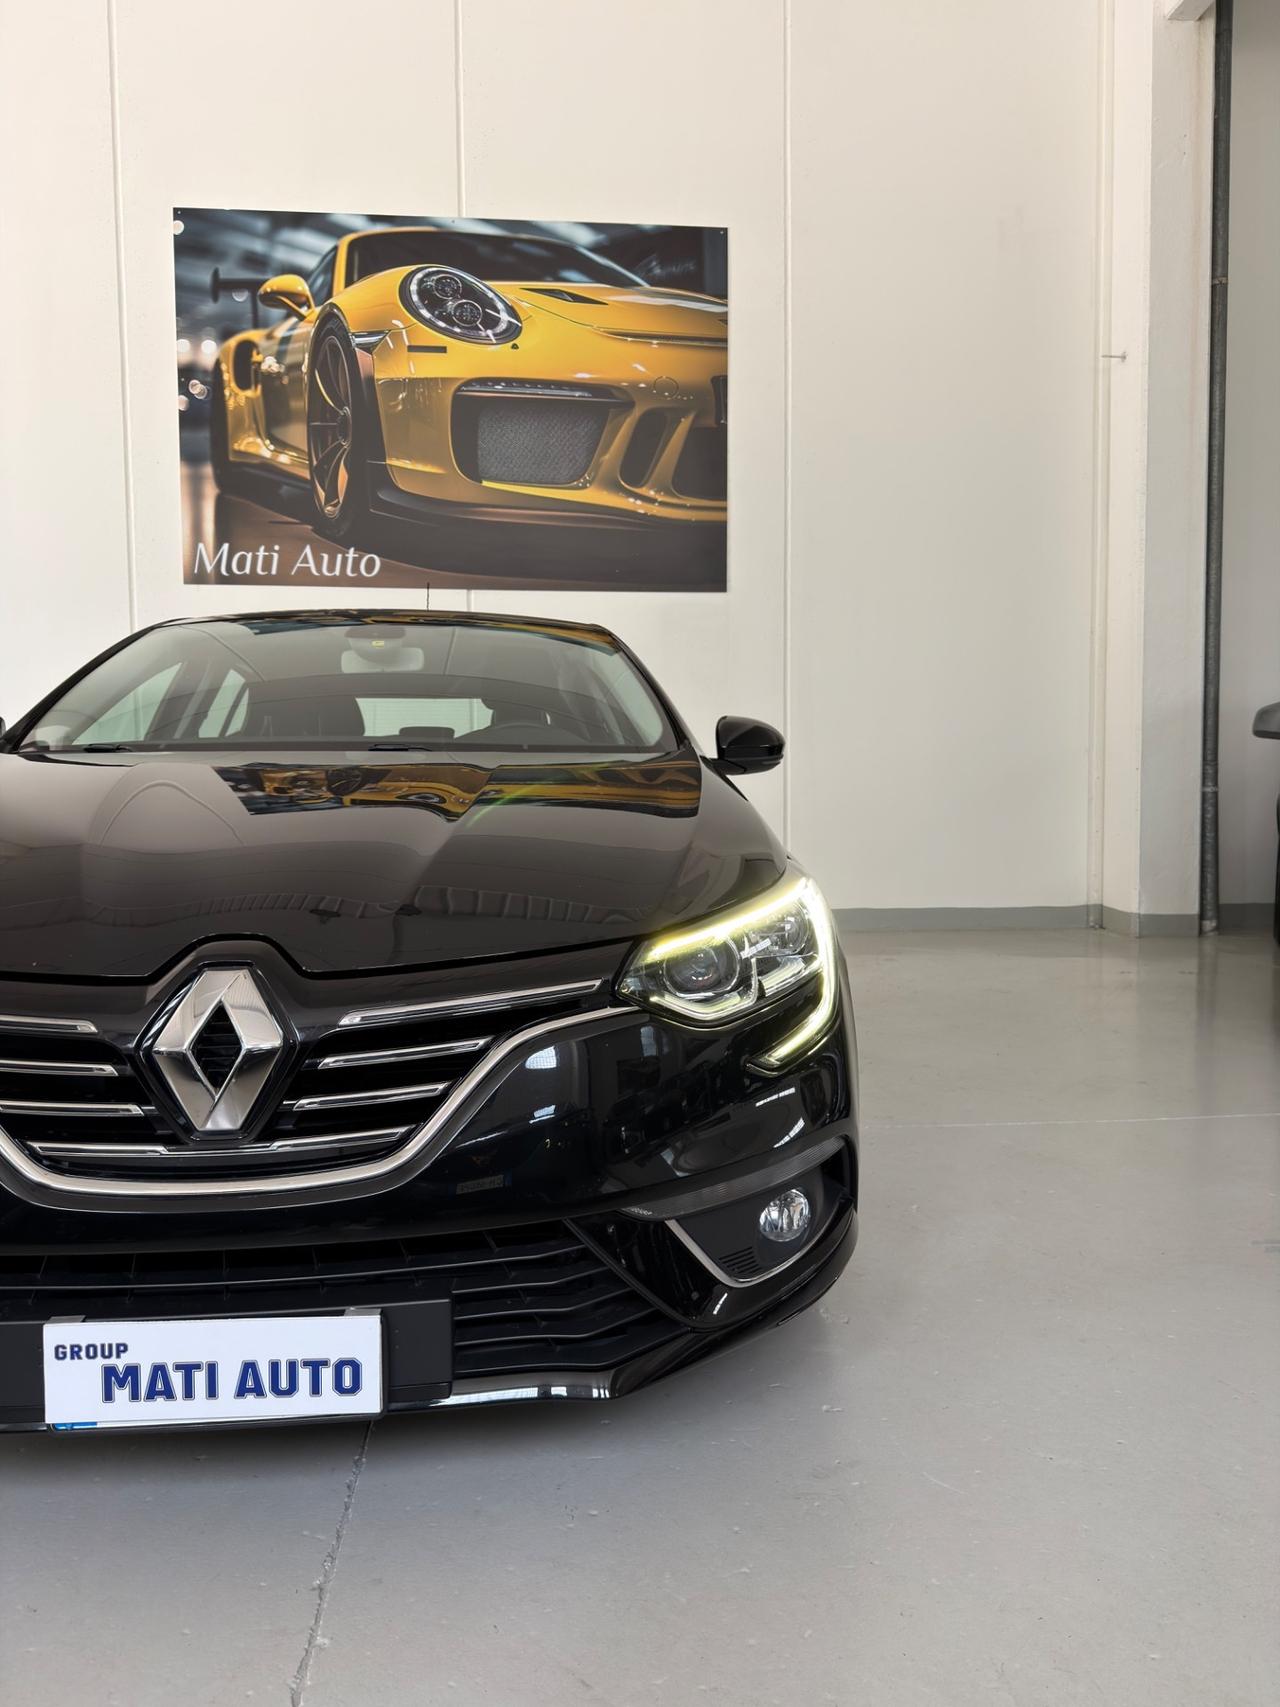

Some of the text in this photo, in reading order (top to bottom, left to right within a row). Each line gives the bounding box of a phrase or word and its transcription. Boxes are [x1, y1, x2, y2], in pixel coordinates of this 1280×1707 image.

[194, 542, 381, 577] Mati Auto
[54, 1342, 129, 1361] GROUP
[101, 1357, 363, 1403] MATI AUTO
